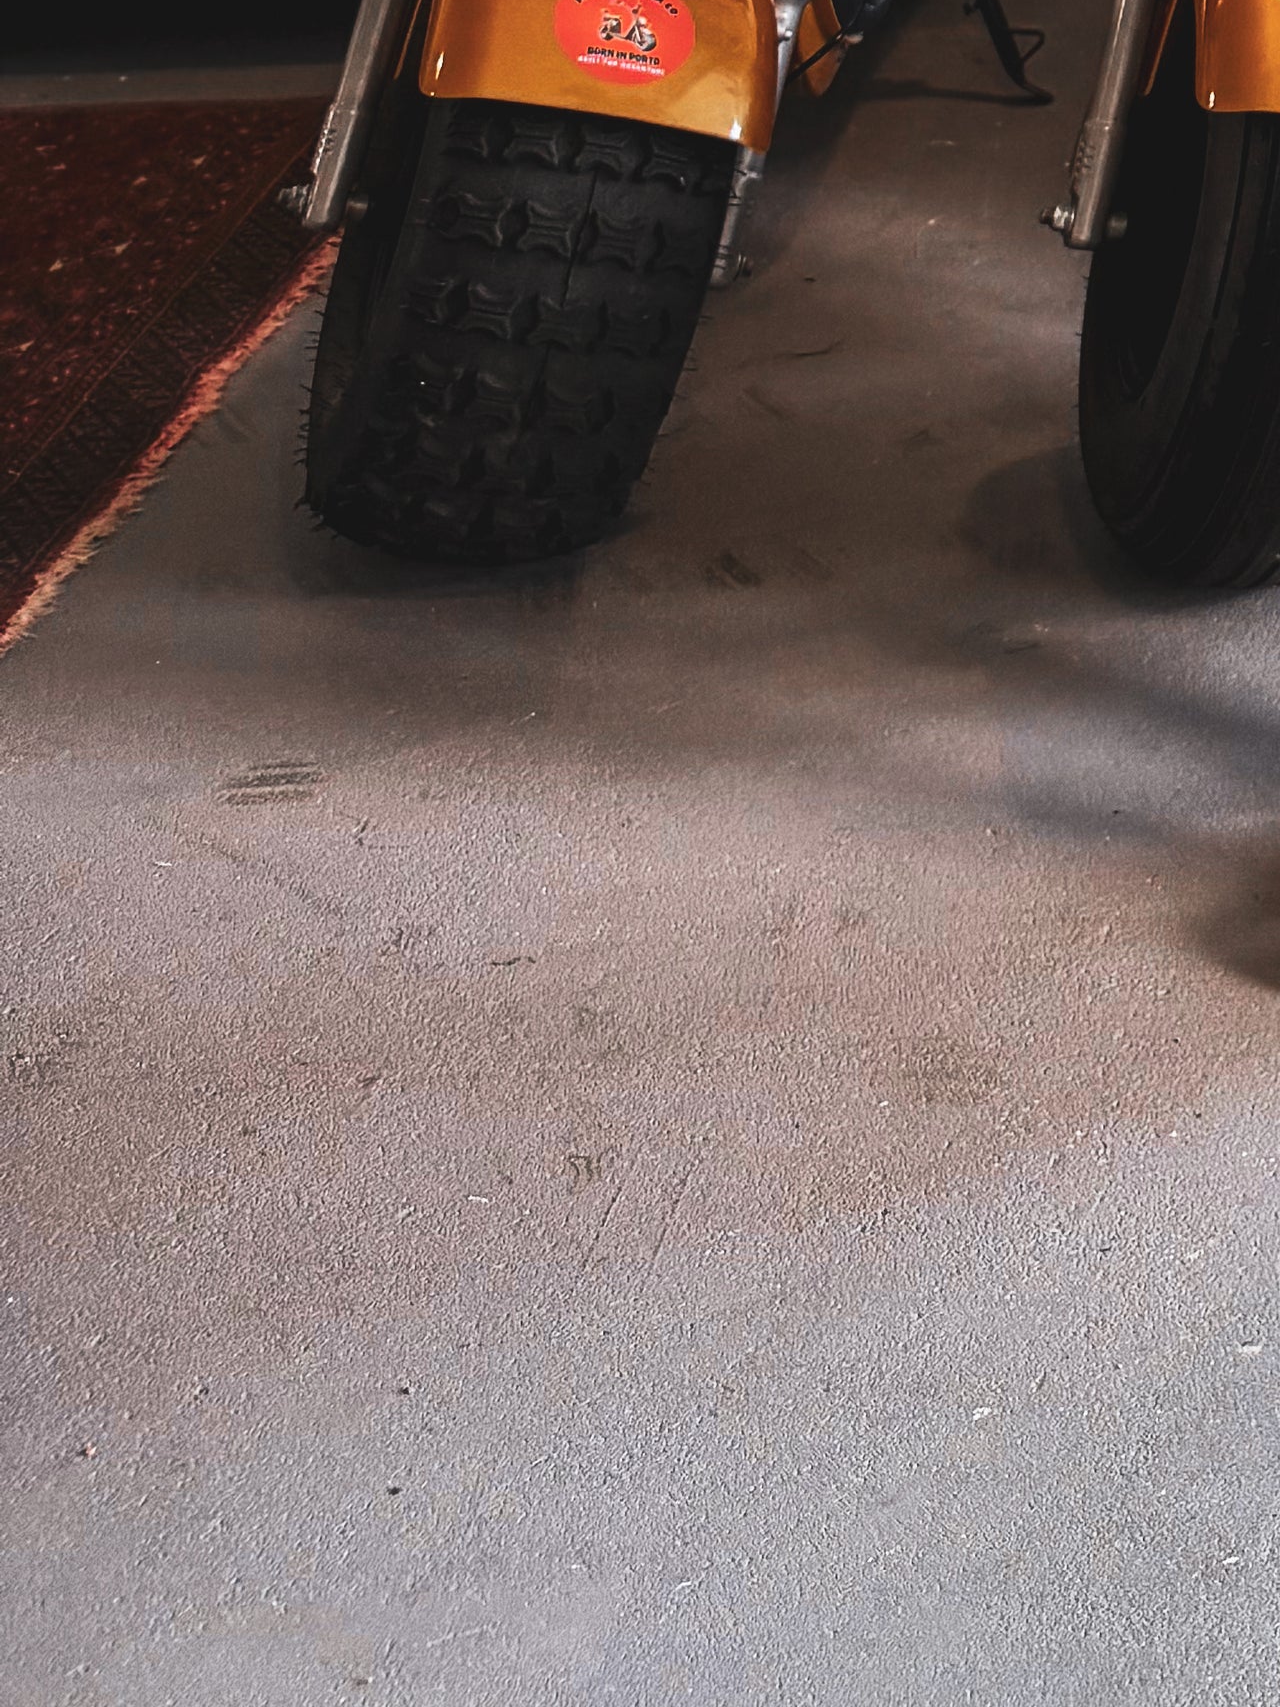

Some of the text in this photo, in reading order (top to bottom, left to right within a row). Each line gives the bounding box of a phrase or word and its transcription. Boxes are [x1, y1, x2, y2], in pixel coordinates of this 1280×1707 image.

[586, 46, 660, 66] BORN IN PORTO
